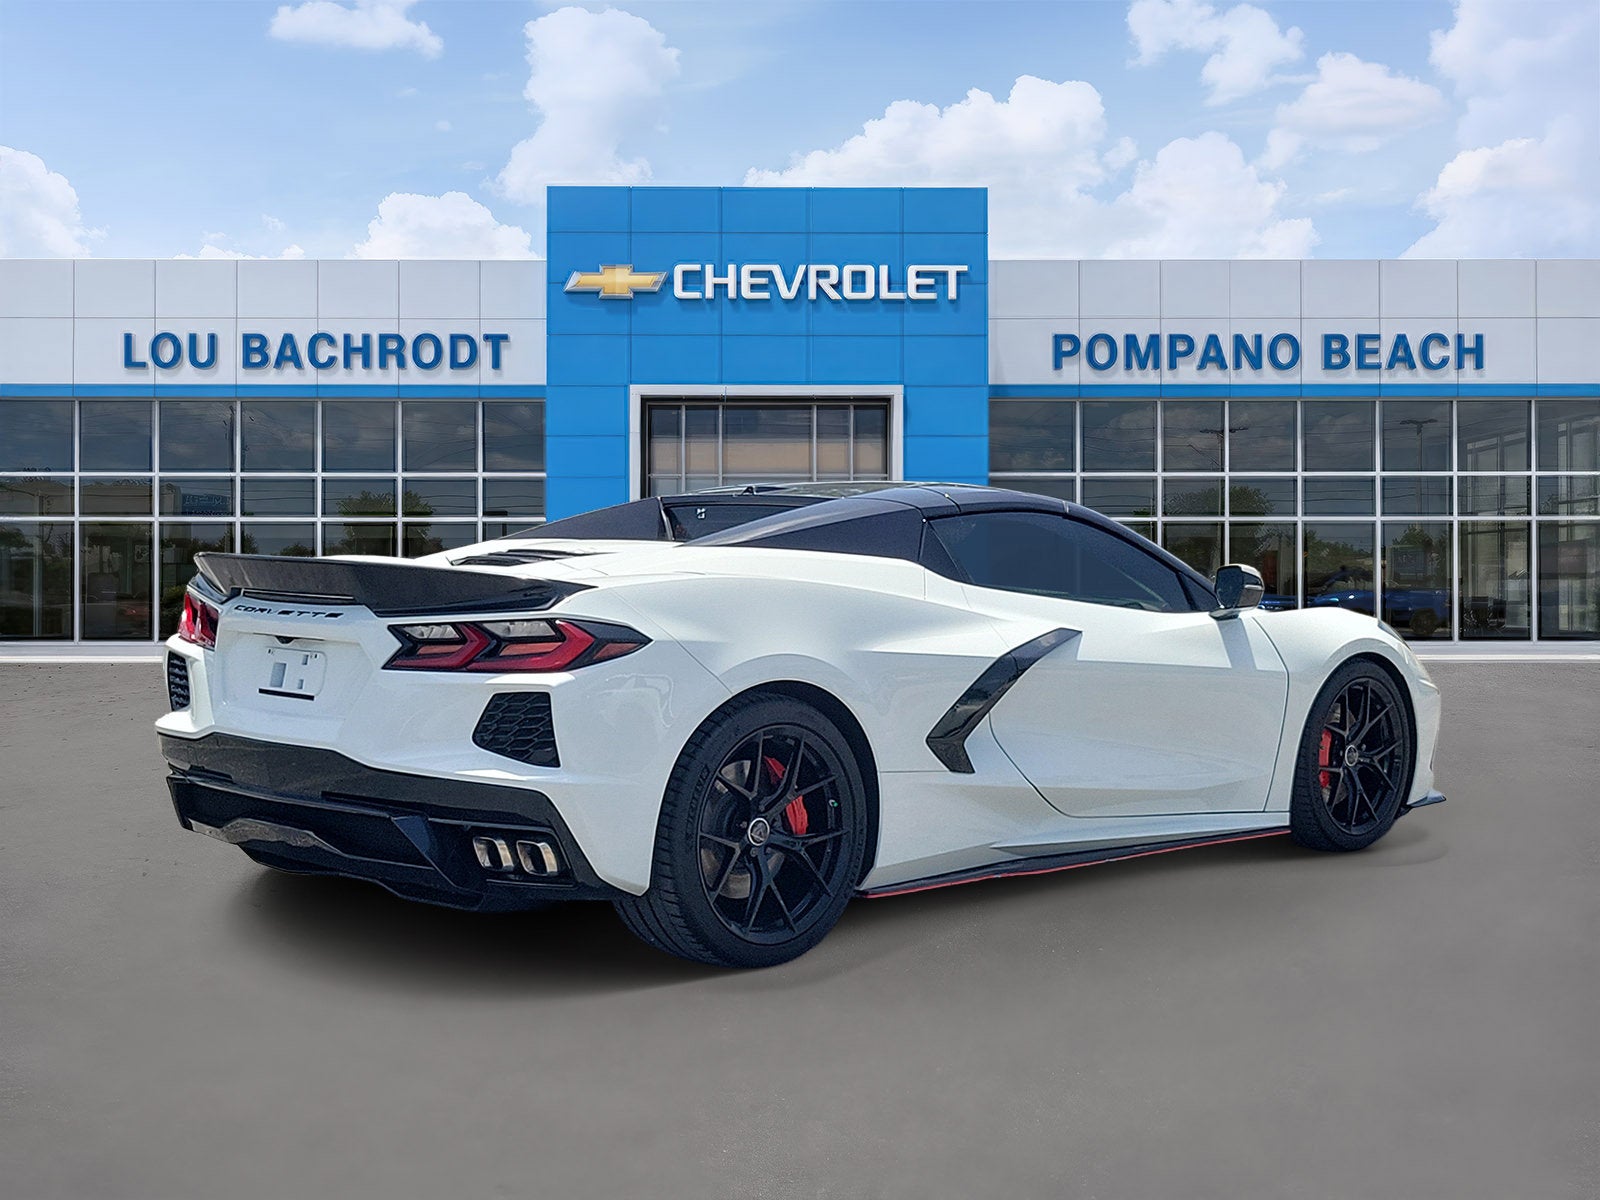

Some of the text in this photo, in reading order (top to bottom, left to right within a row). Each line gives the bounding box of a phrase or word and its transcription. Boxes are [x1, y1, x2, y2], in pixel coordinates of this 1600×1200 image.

[673, 263, 969, 301] CHEVROLET
[123, 332, 508, 371] LOU BACHRODT
[1053, 332, 1484, 371] POMPANO BEACH
